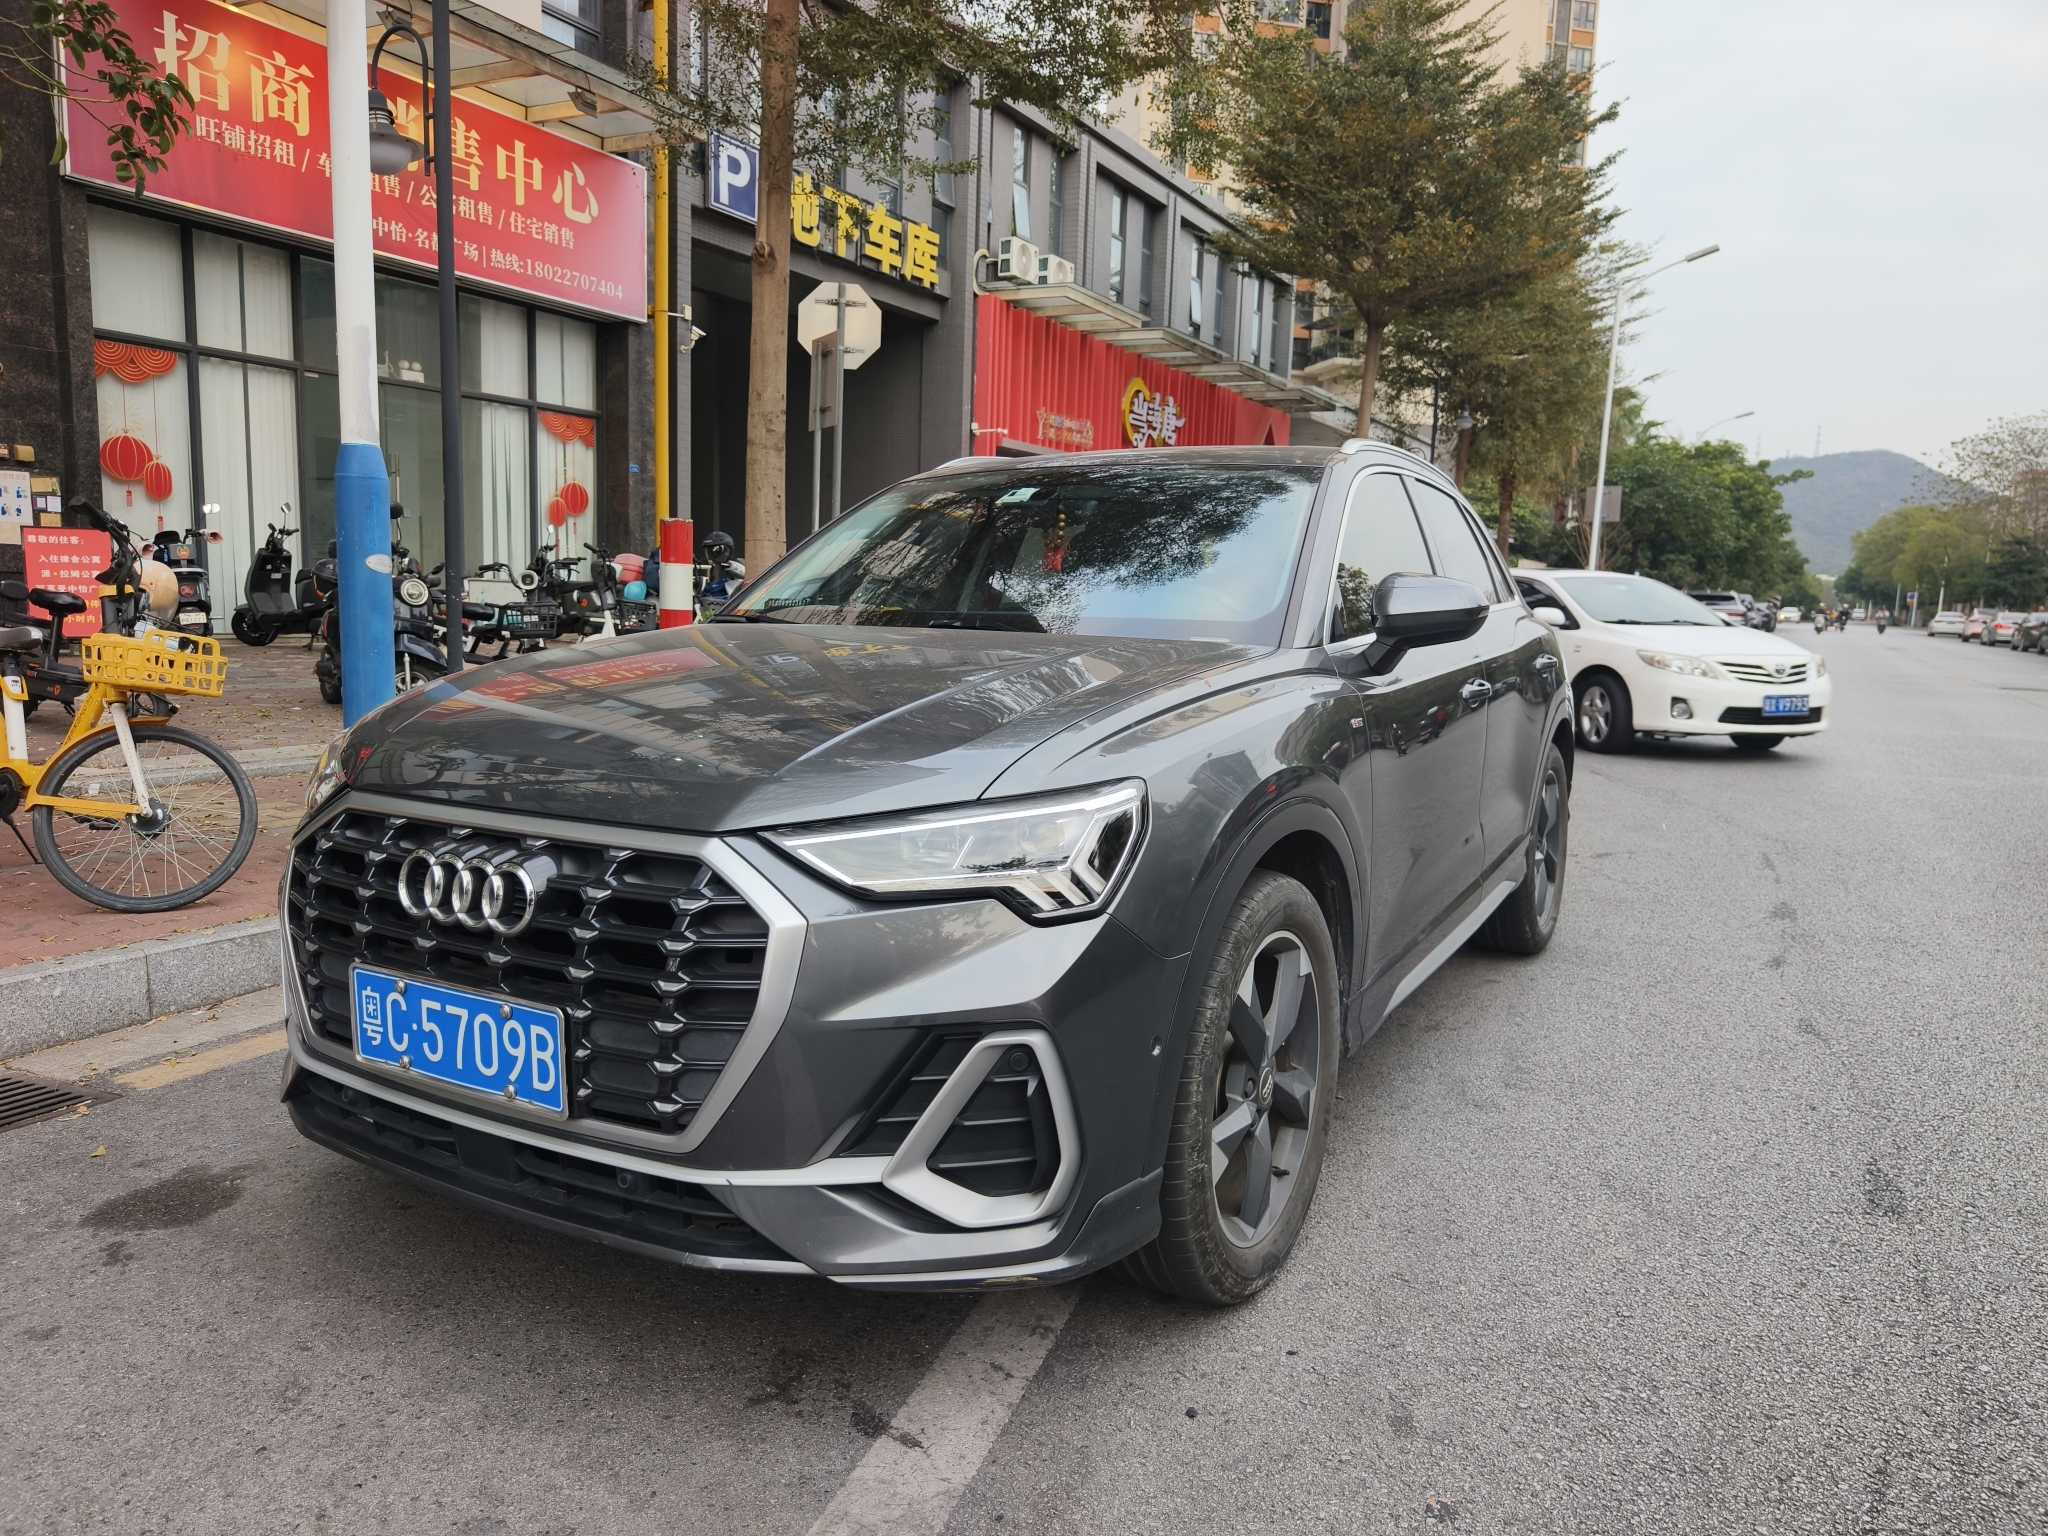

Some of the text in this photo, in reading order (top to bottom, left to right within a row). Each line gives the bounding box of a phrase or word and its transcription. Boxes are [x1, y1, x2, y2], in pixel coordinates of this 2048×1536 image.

[153, 10, 315, 136] 招商
[196, 113, 296, 168] 旺铺招租
[420, 184, 493, 226] 公租售
[509, 211, 576, 249] 住宅销售
[718, 144, 751, 207] P
[790, 171, 940, 288] 地下车库
[362, 985, 556, 1092] 粤C·5709B
